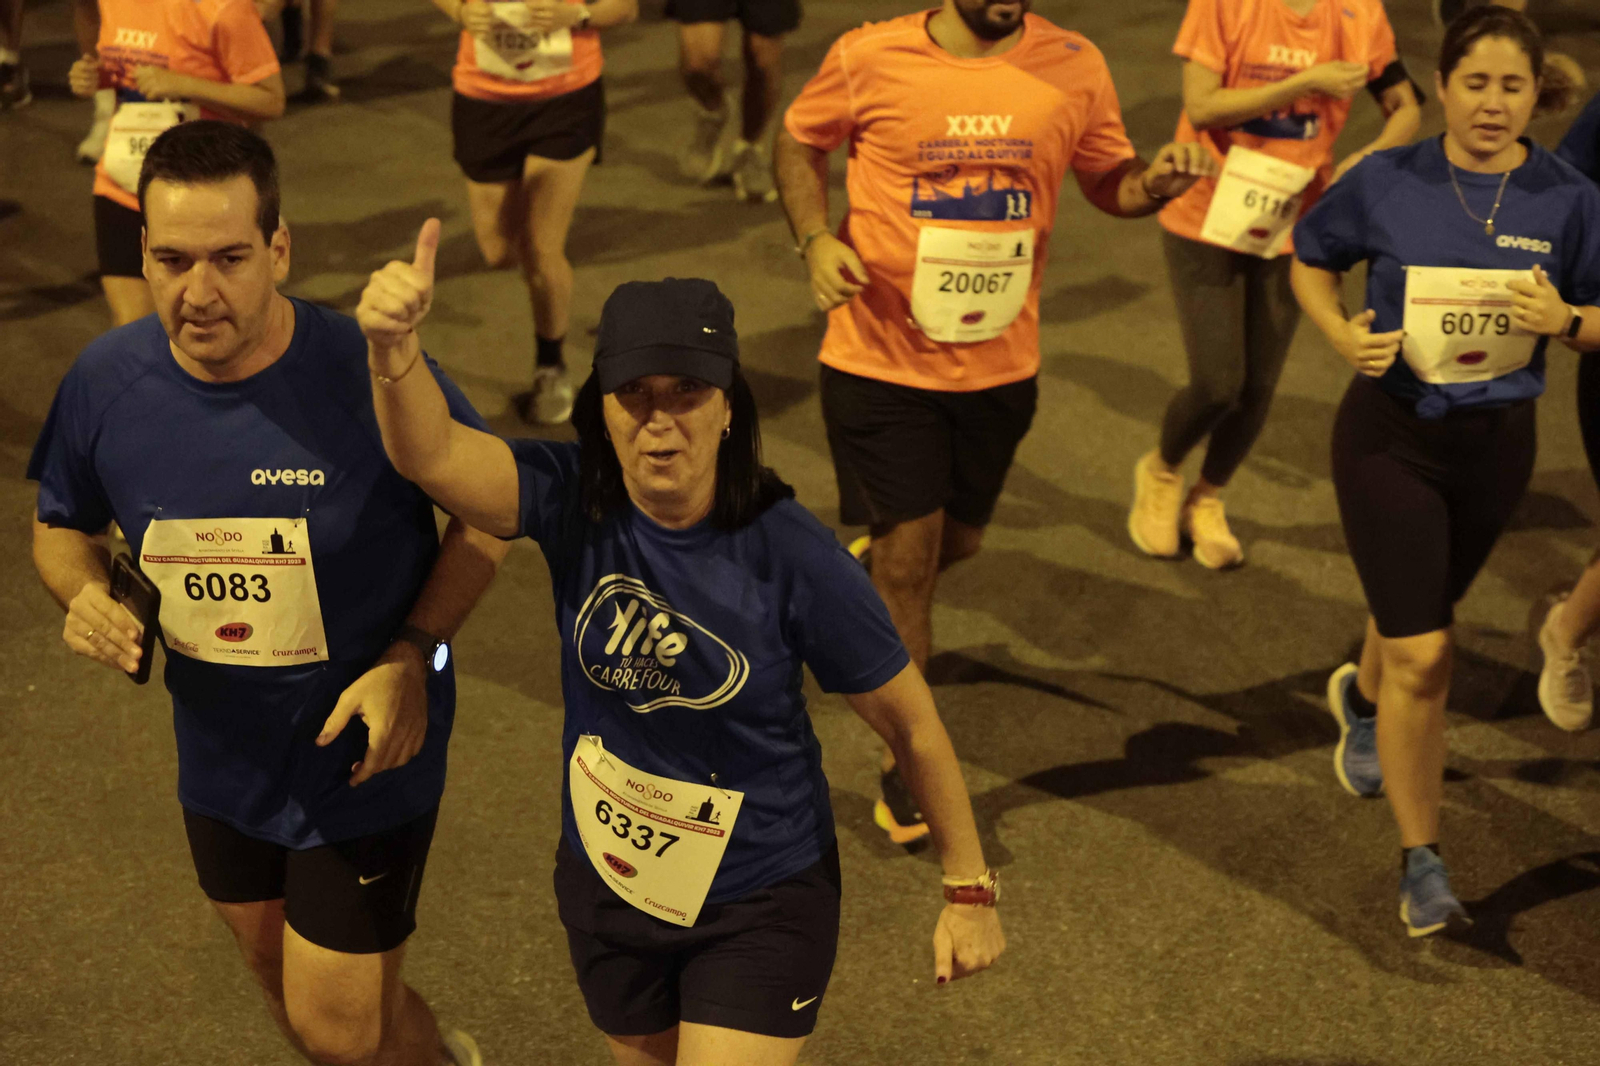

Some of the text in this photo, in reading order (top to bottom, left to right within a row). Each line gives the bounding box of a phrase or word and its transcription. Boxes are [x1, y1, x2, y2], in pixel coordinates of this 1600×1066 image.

[945, 114, 1012, 136] XXXV
[1495, 234, 1552, 254] ayesa
[938, 270, 1013, 294] 20067
[1441, 312, 1510, 336] 6079
[251, 468, 325, 486] ayesa
[232, 557, 275, 565] GUADALQUIVIR
[184, 572, 271, 603] 6083
[272, 646, 317, 657] Cruzcampo
[633, 657, 659, 669] HACES
[590, 664, 681, 696] CARREFOUR
[595, 799, 681, 858] 6337
[644, 897, 687, 918] Cruzcampo
